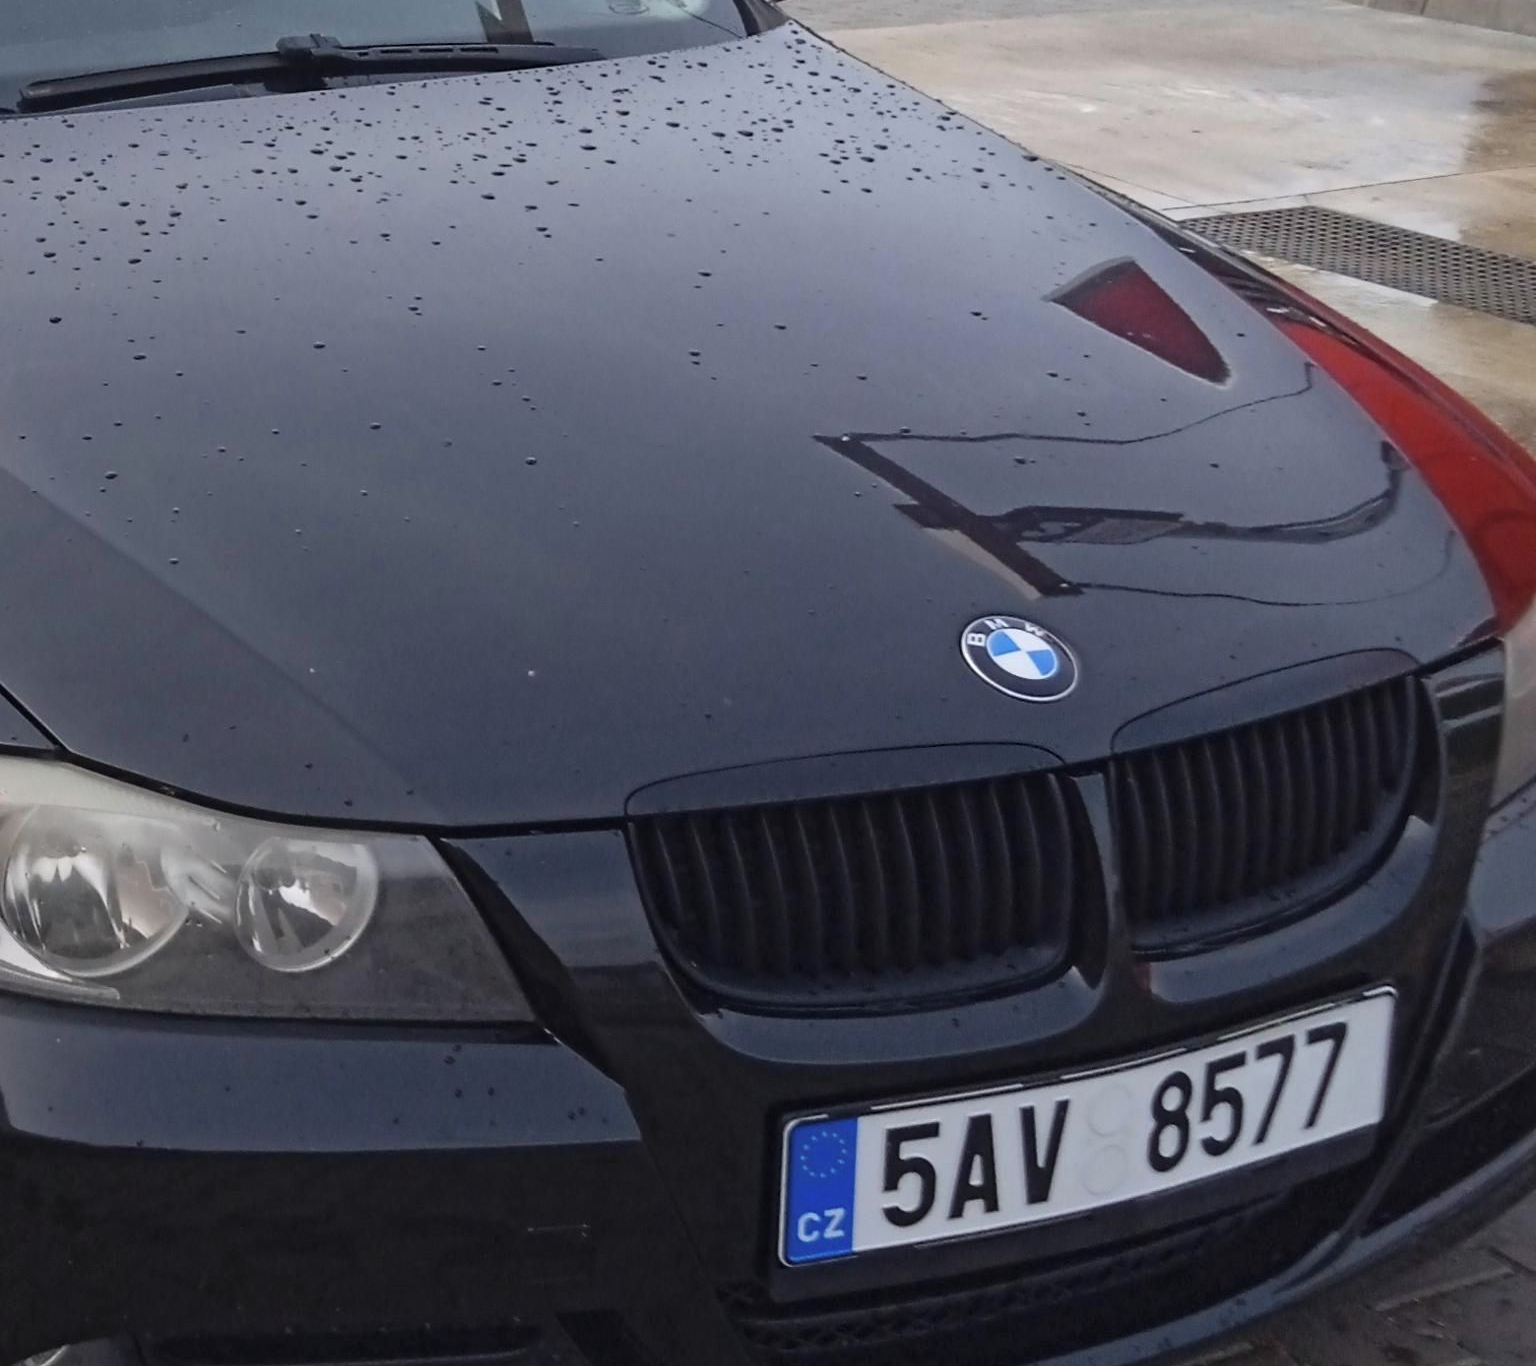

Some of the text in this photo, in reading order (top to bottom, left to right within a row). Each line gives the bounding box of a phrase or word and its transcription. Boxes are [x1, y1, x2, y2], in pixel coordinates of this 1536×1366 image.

[966, 618, 1046, 647] BMW
[882, 1022, 1349, 1228] 5AV 8577
[797, 1208, 845, 1243] CZ
